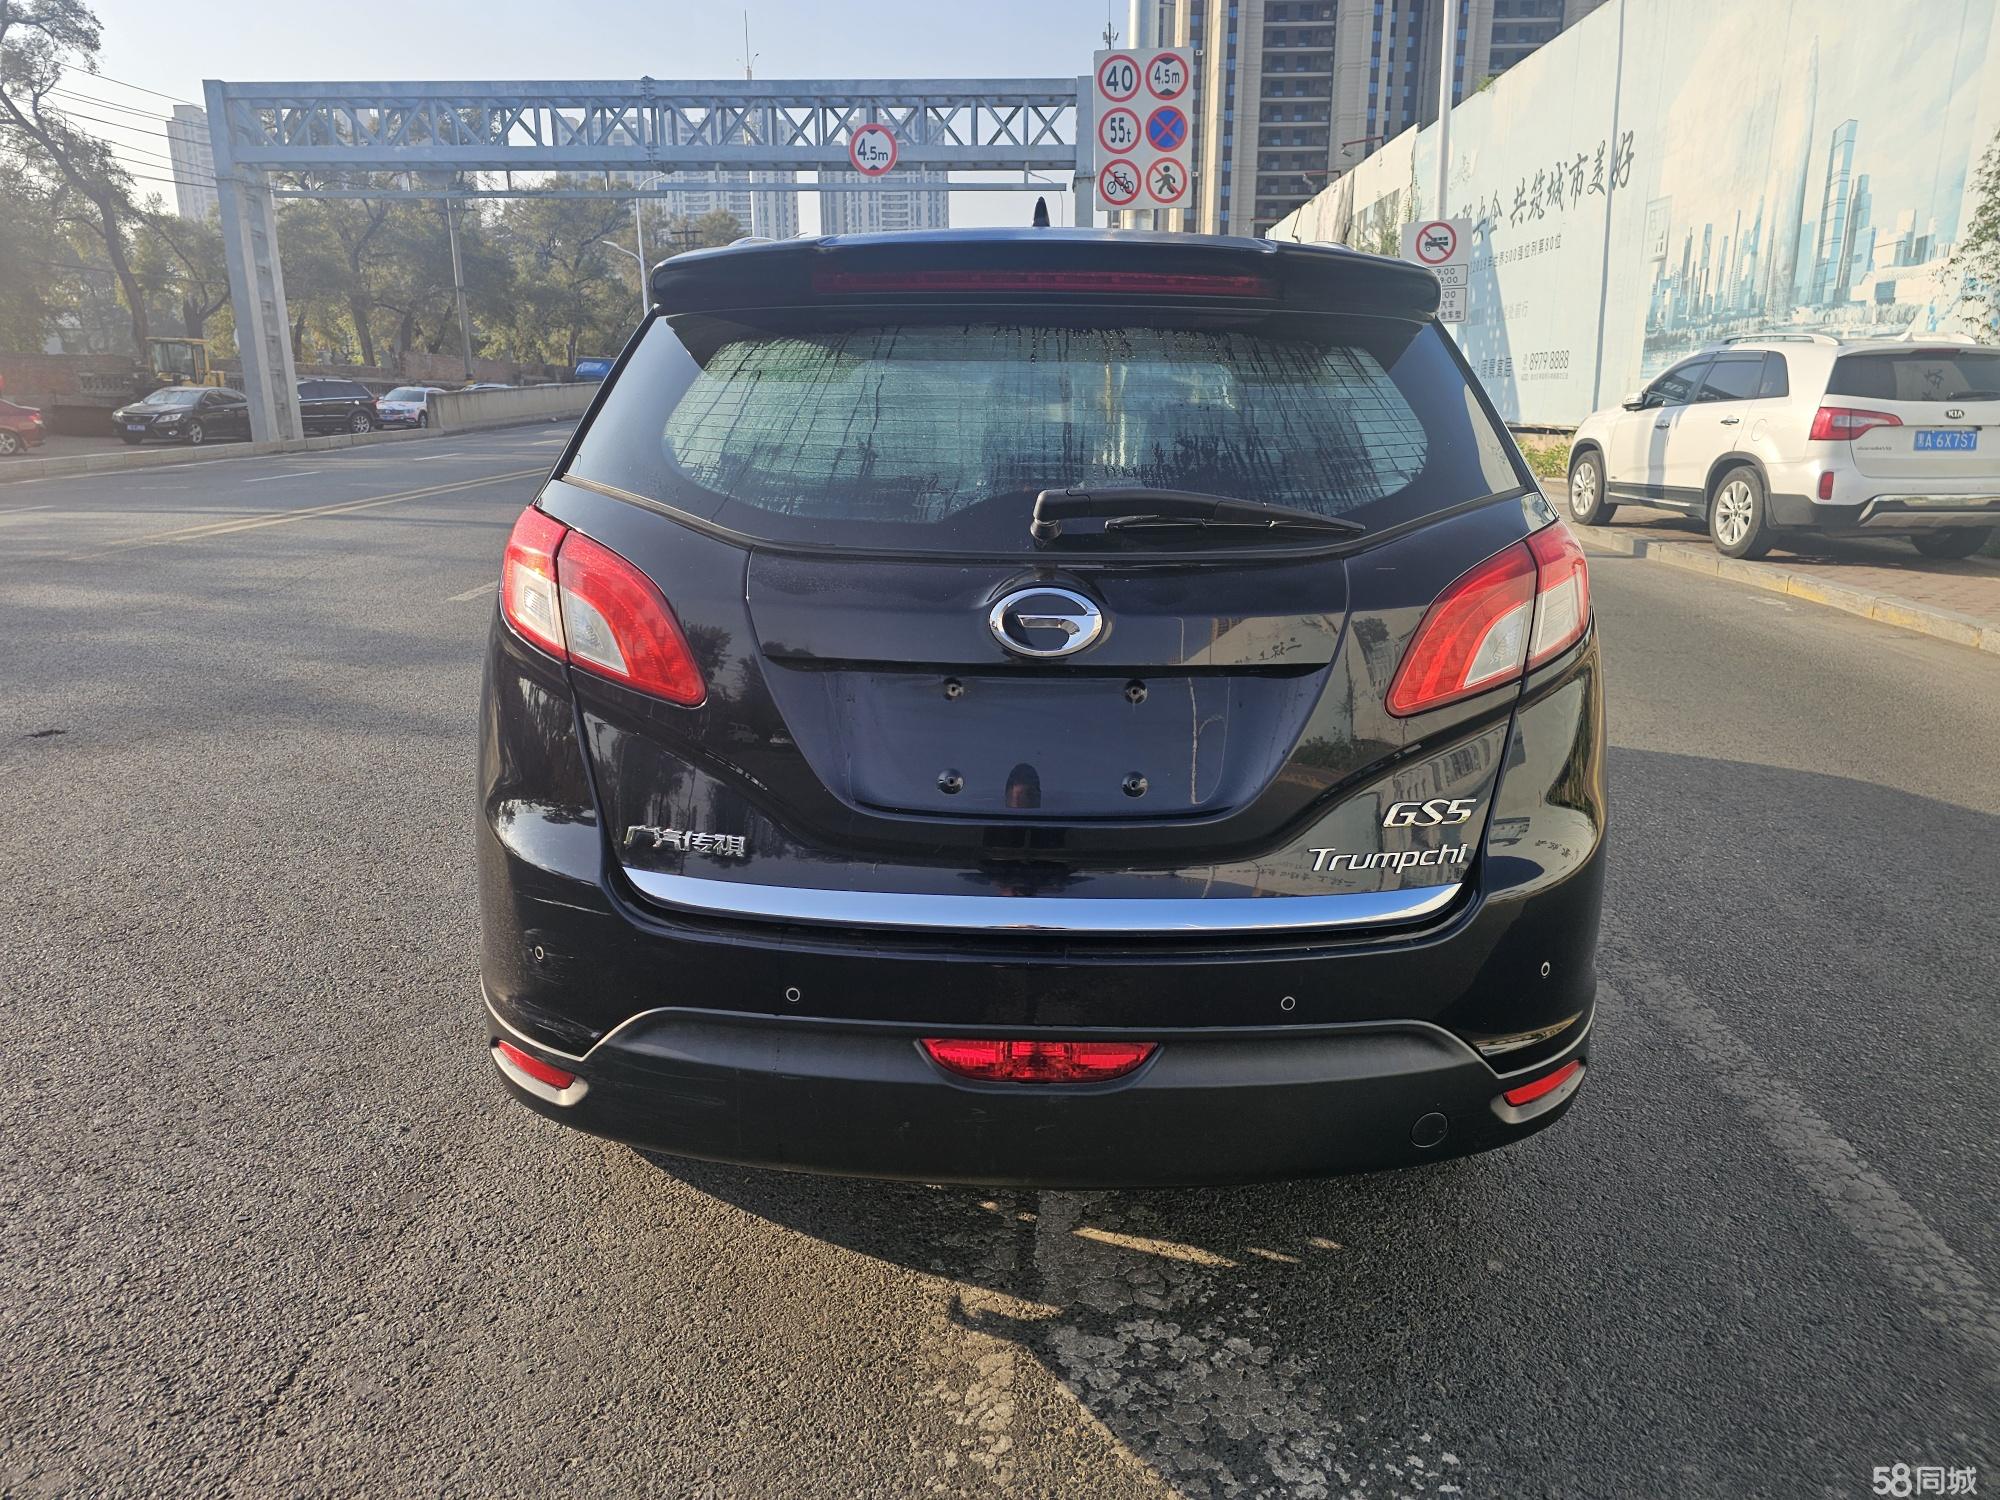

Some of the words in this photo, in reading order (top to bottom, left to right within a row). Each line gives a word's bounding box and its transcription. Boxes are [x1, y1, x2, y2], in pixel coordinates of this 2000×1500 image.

[1106, 65, 1133, 92] 40
[1154, 65, 1180, 84] 4.5m
[1110, 117, 1131, 143] 55t
[857, 138, 889, 161] 4.5m
[1529, 352, 1548, 371] 8979
[1549, 350, 1570, 369] 8888
[1948, 410, 1963, 418] KIA
[1383, 798, 1477, 828] GS5
[623, 825, 746, 857] 广汽传祺
[1308, 843, 1468, 874] Trumpchi
